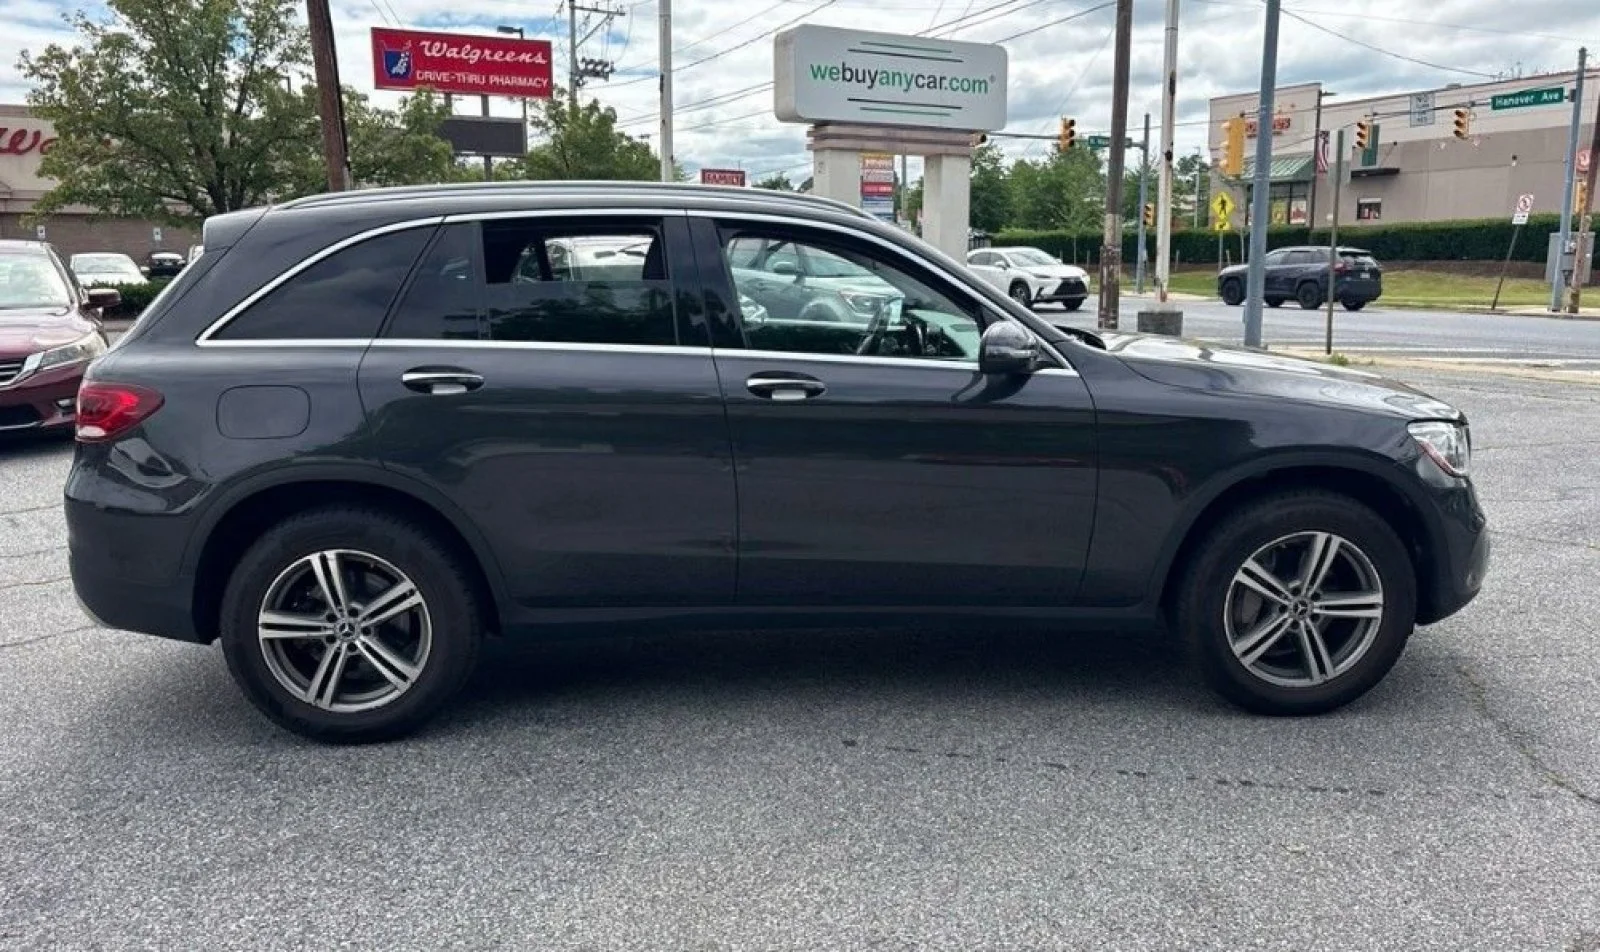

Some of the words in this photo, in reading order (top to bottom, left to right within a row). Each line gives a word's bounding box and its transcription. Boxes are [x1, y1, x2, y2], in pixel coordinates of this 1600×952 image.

[419, 40, 548, 65] Walgreens
[416, 70, 486, 84] DRIVE-THRU
[489, 75, 549, 89] PHARMACY
[809, 61, 989, 94] webuyanycar.com
[1541, 92, 1559, 101] Ave
